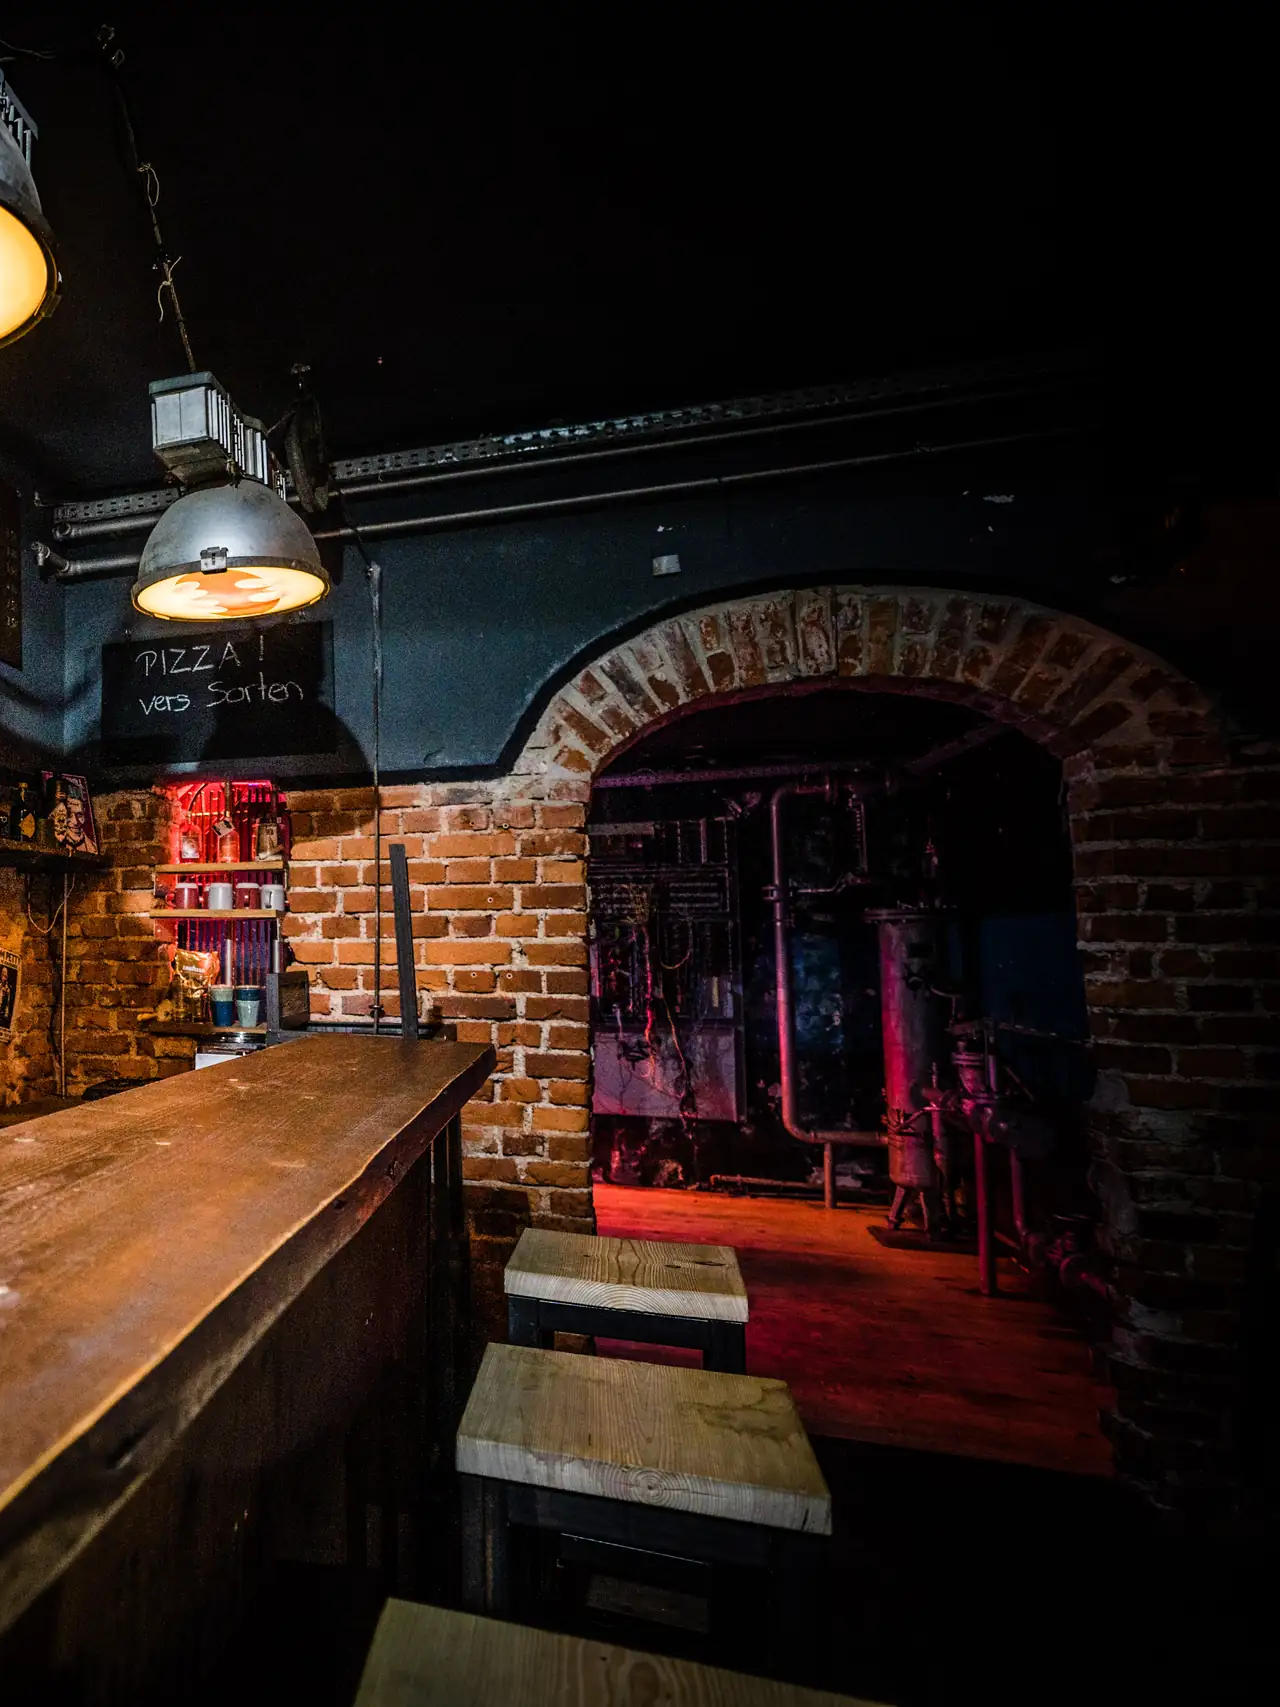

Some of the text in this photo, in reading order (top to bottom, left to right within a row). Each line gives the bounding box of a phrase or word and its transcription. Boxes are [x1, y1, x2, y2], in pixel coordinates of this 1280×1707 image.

[135, 640, 241, 678] PIZZA
[138, 671, 304, 716] vers Sorten
